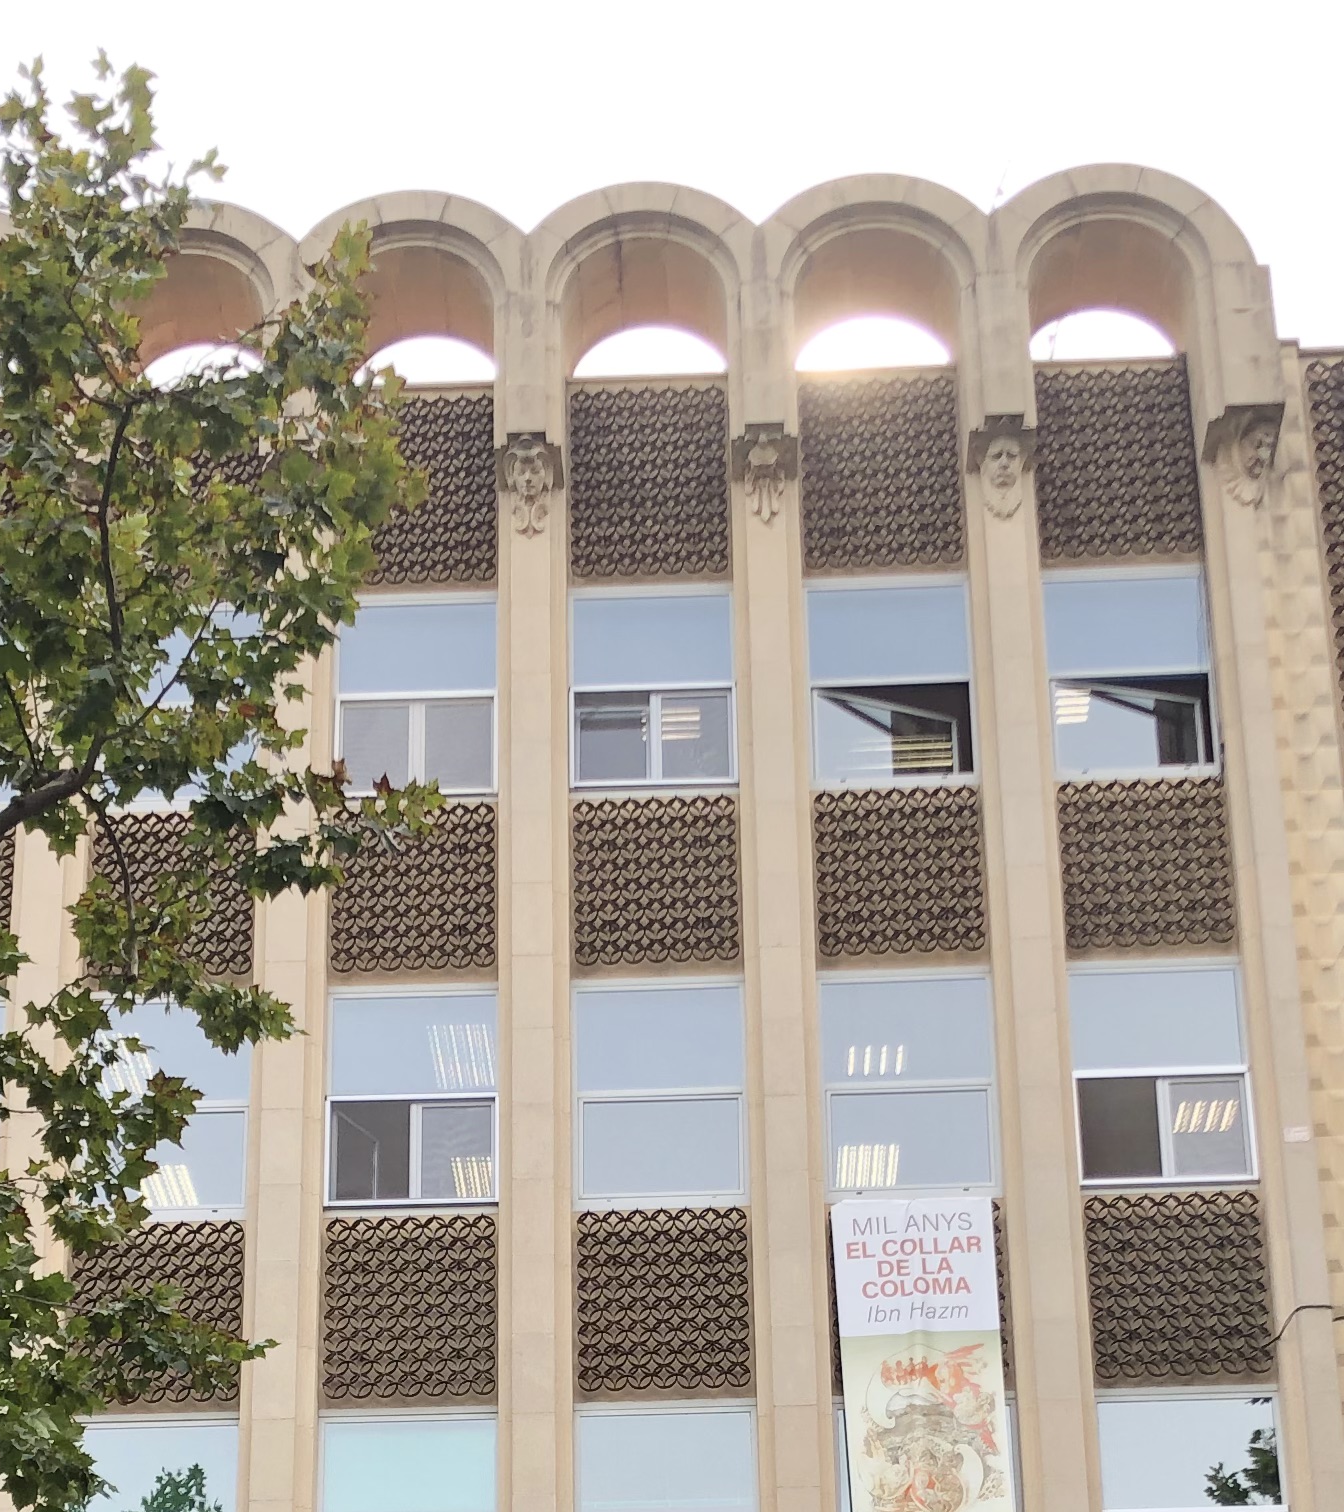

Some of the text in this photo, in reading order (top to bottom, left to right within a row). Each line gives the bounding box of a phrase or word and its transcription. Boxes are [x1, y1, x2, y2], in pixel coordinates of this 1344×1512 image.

[852, 1211, 973, 1237] MIL ANYS
[846, 1235, 982, 1260] EL COLLAR
[876, 1257, 954, 1278] DE LA
[861, 1276, 971, 1299] COLOMA
[867, 1301, 969, 1323] Ibn Hazm
